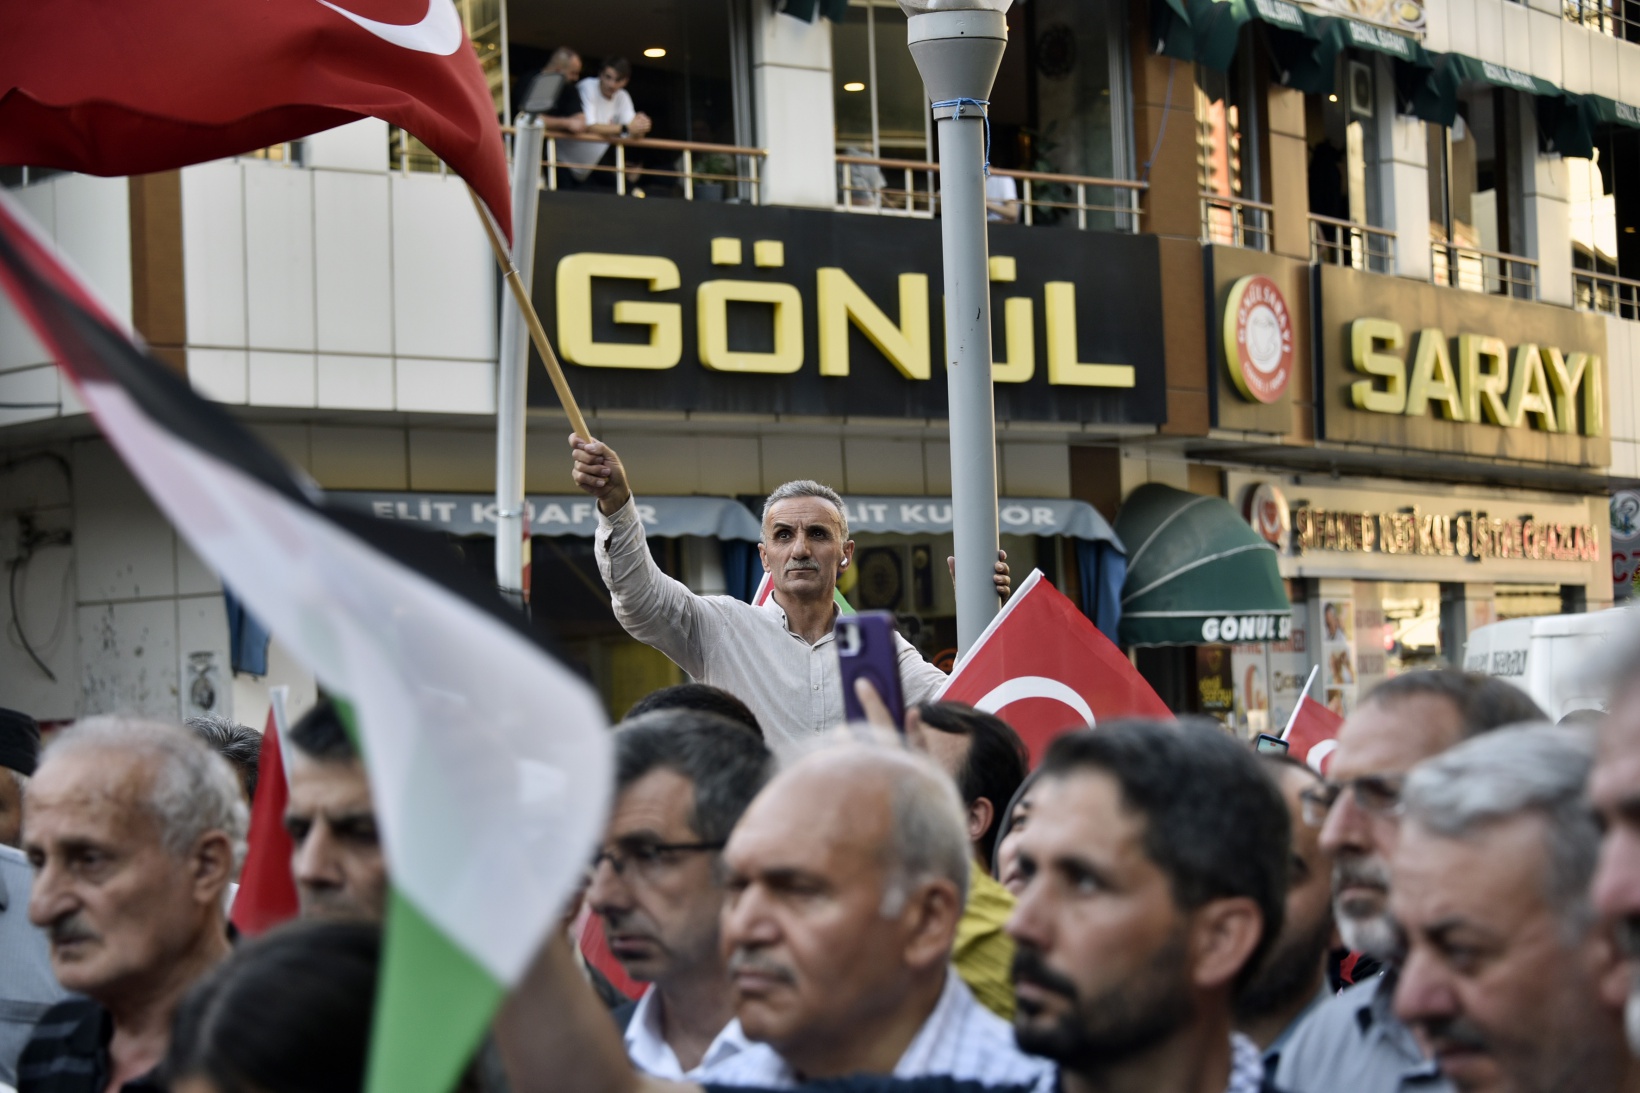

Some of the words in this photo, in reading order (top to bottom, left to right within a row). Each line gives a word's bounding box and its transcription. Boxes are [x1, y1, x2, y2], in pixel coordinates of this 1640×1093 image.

[1352, 317, 1603, 437] SARAYI
[373, 498, 457, 522] ELİT
[472, 502, 658, 525] KAFR
[846, 502, 888, 523] LİT
[901, 503, 1056, 526] KUÖR
